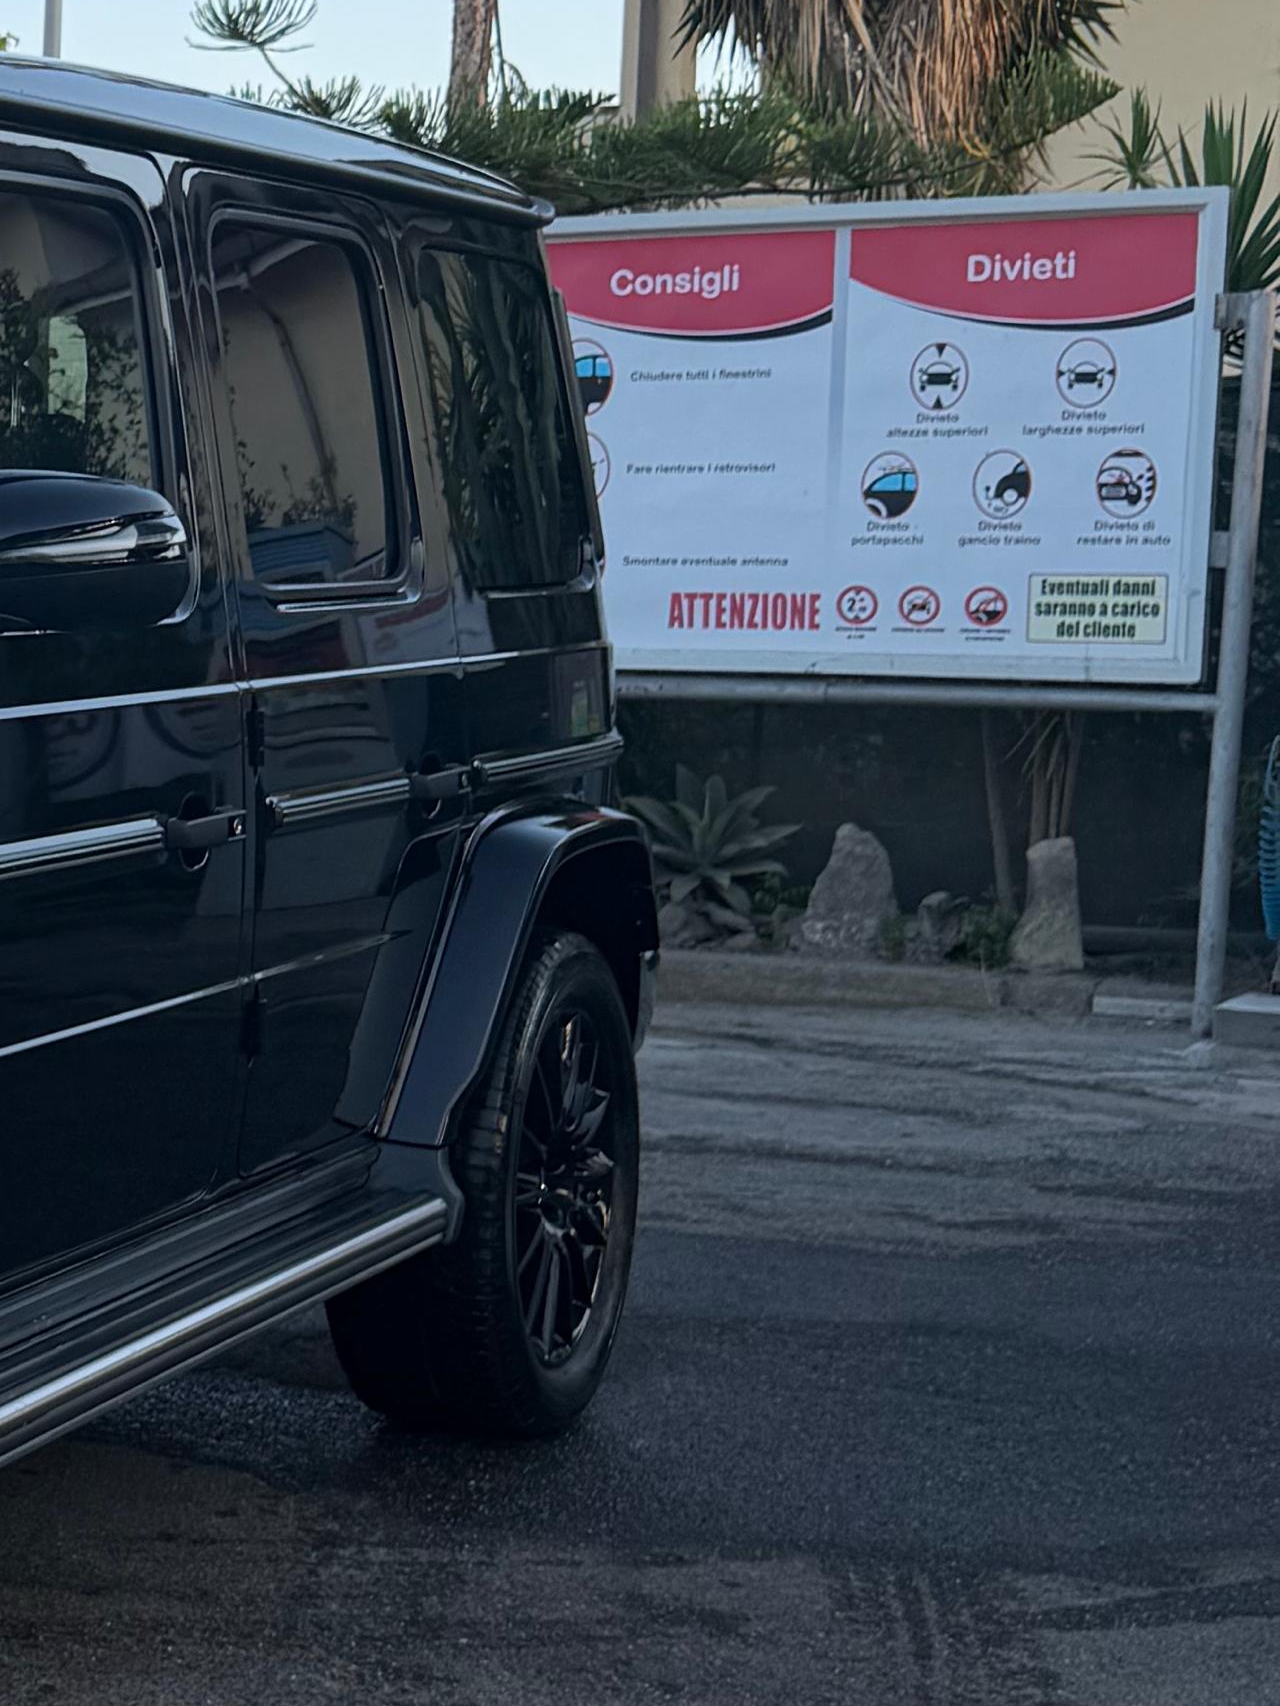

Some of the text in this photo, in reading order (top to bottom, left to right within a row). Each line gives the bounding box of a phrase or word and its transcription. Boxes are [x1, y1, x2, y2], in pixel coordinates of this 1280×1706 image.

[966, 249, 1076, 282] Divieti
[610, 263, 740, 299] Consigli
[630, 370, 682, 382] Chiudere
[686, 369, 709, 381] tutti
[719, 368, 772, 380] finestrini
[916, 413, 959, 424] Divieto
[1062, 410, 1106, 421] Divieto
[932, 425, 988, 438] superiori
[1086, 423, 1145, 436] superiori
[626, 464, 652, 474] Fare
[655, 463, 704, 474] rientrare
[713, 463, 775, 474] retrovisori
[867, 521, 910, 532] Divieto
[977, 520, 1022, 532] Divieto
[1094, 520, 1155, 532] Divieto di
[851, 535, 924, 547] portapacchi
[958, 535, 1041, 548] gancio traino
[1077, 535, 1171, 545] restare in auto
[622, 556, 788, 567] Smontare eventuale antenna
[1040, 578, 1156, 596] Eventuali danni
[667, 592, 821, 631] ATTENZIONE
[1034, 600, 1160, 618] saranno a carico
[1056, 620, 1136, 639] del cliente
